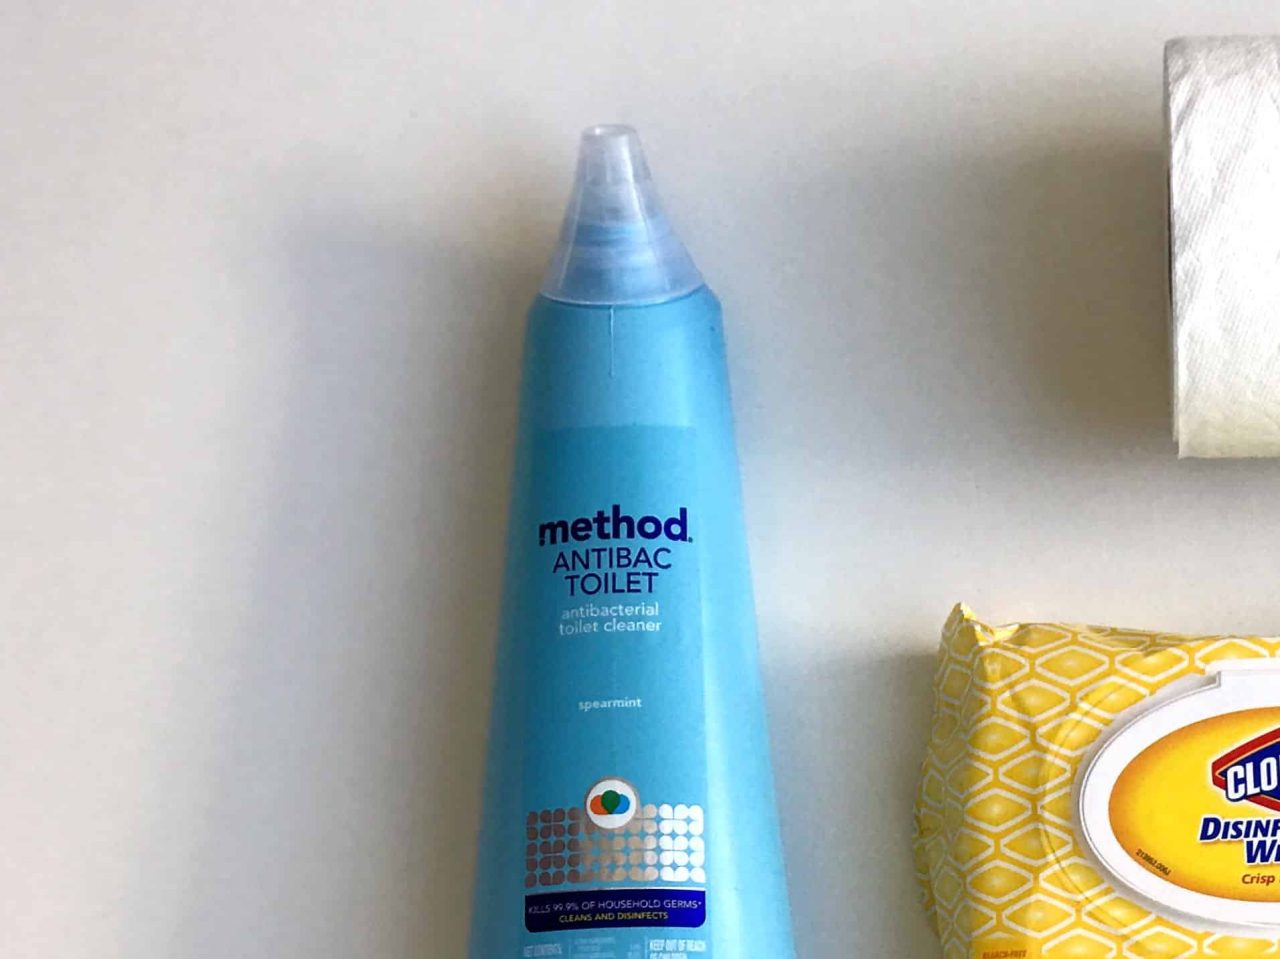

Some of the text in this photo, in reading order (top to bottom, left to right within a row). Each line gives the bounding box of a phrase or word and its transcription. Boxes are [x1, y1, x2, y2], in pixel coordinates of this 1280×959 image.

[553, 547, 672, 573] ANTIBAC
[564, 572, 659, 596] TOILET
[561, 602, 659, 620] antibacterial
[559, 618, 662, 636] toilet cleaner
[578, 696, 642, 712] spearmint
[1241, 873, 1276, 886] Crisp
[528, 905, 551, 914] KILLS
[581, 901, 596, 910] OF
[598, 899, 661, 910] HOUSEHOLD
[559, 911, 669, 923] CLEANS AND DISINFECTS
